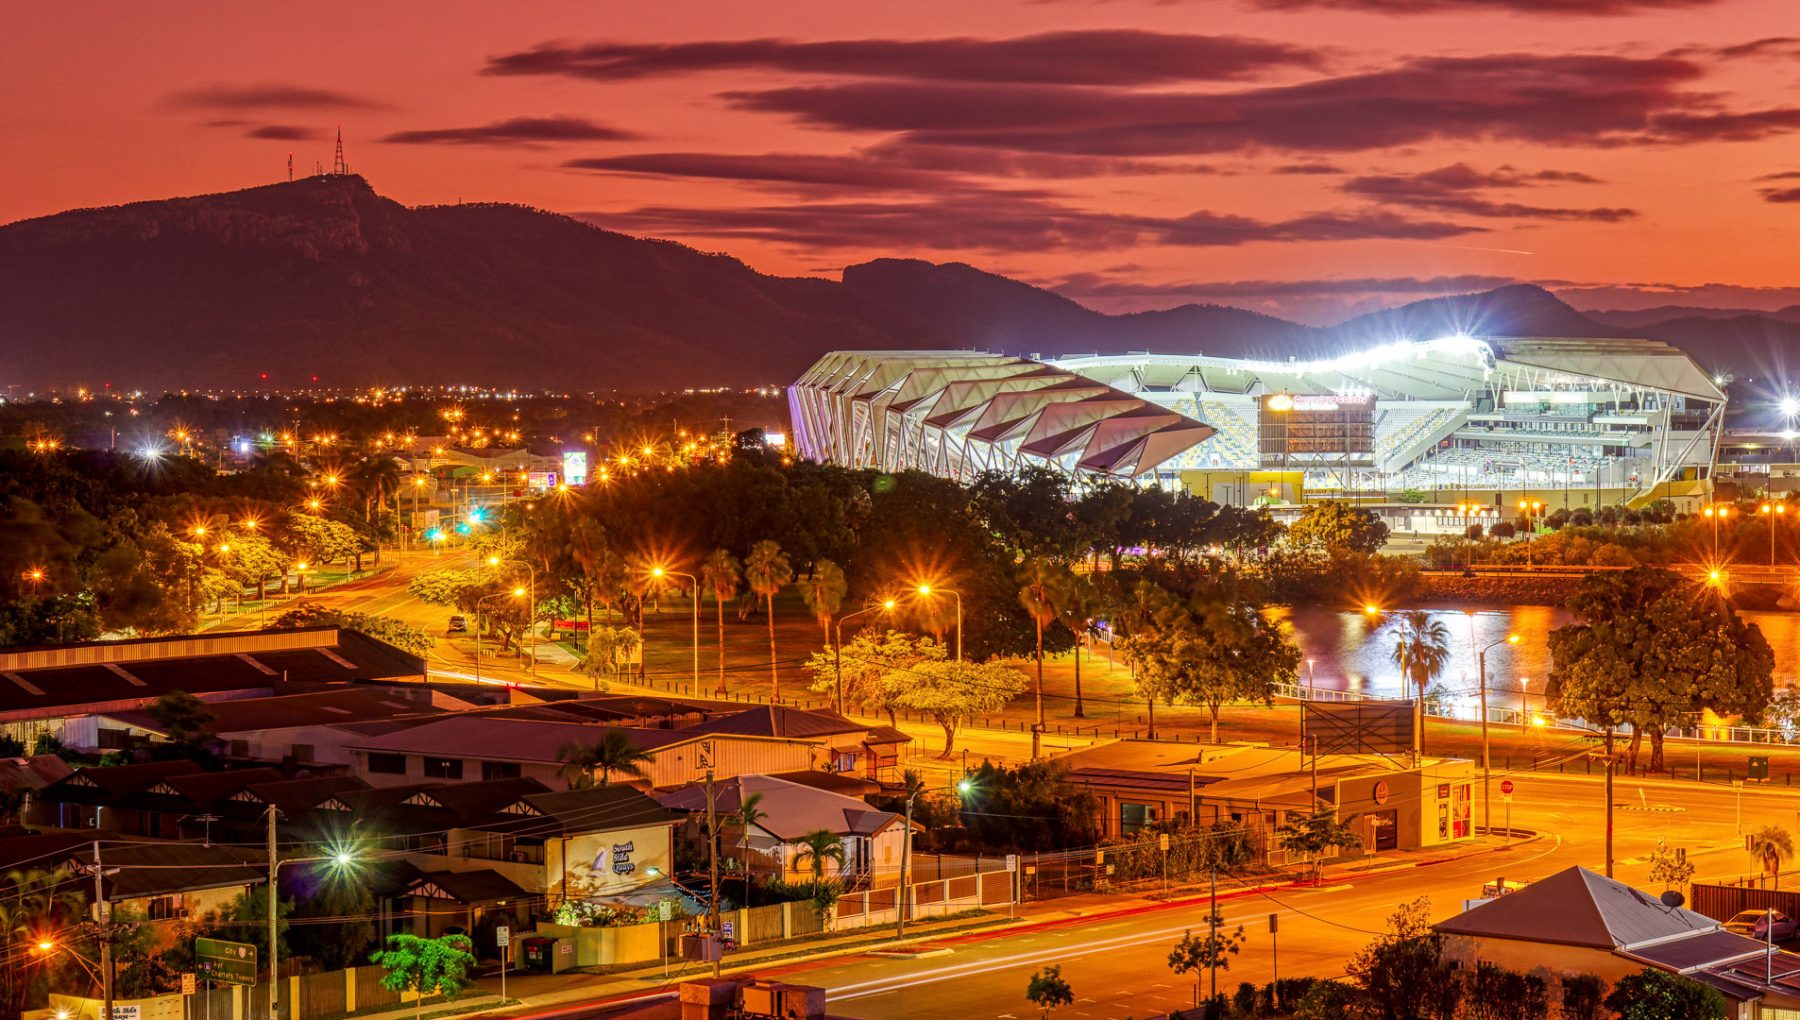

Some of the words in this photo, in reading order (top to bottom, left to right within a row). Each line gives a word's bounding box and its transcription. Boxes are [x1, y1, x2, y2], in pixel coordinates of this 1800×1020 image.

[613, 841, 633, 852] South
[613, 852, 629, 862] Side
[612, 863, 635, 875] Quays
[225, 947, 236, 956] City
